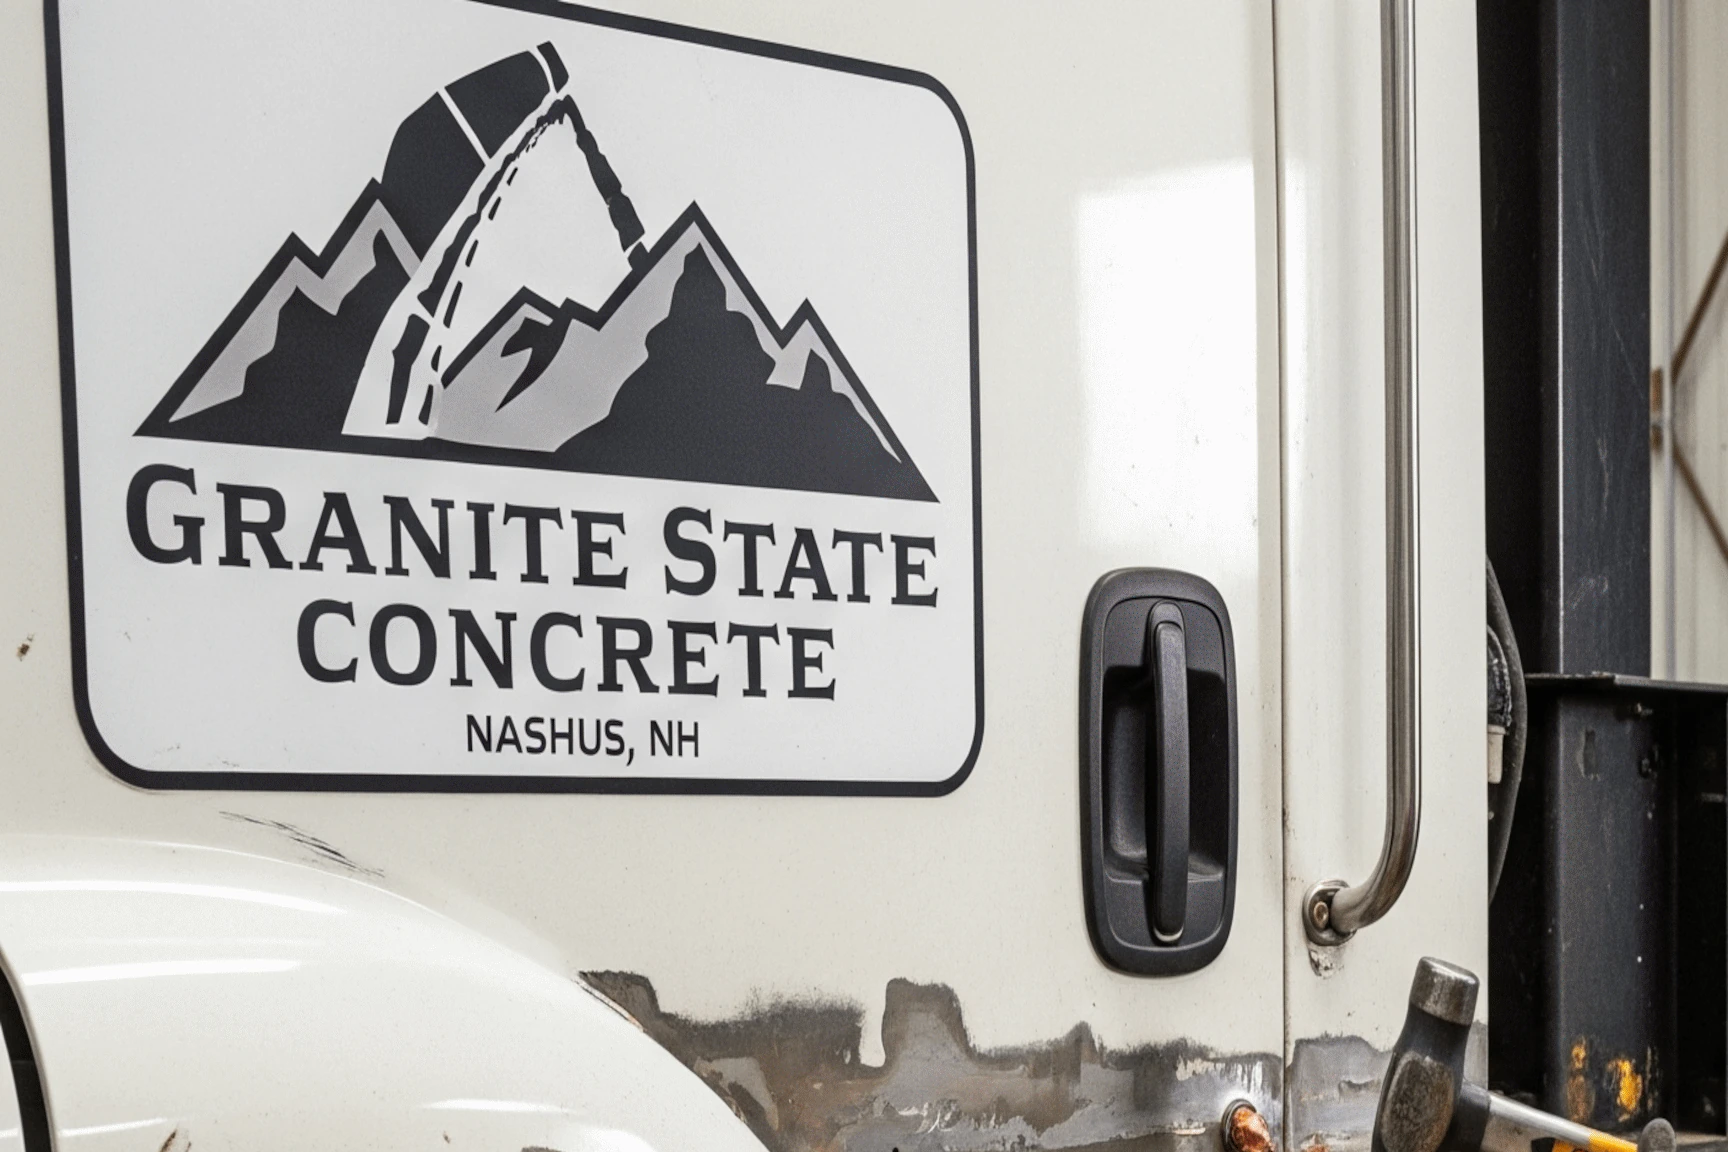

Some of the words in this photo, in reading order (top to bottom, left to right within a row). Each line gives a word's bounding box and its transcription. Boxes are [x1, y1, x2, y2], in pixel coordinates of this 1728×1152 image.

[126, 463, 629, 590] GRANITE
[662, 506, 939, 608] STATE
[296, 598, 837, 701] CONCRETE
[466, 714, 635, 767] NASHUS,
[650, 719, 700, 758] NH
